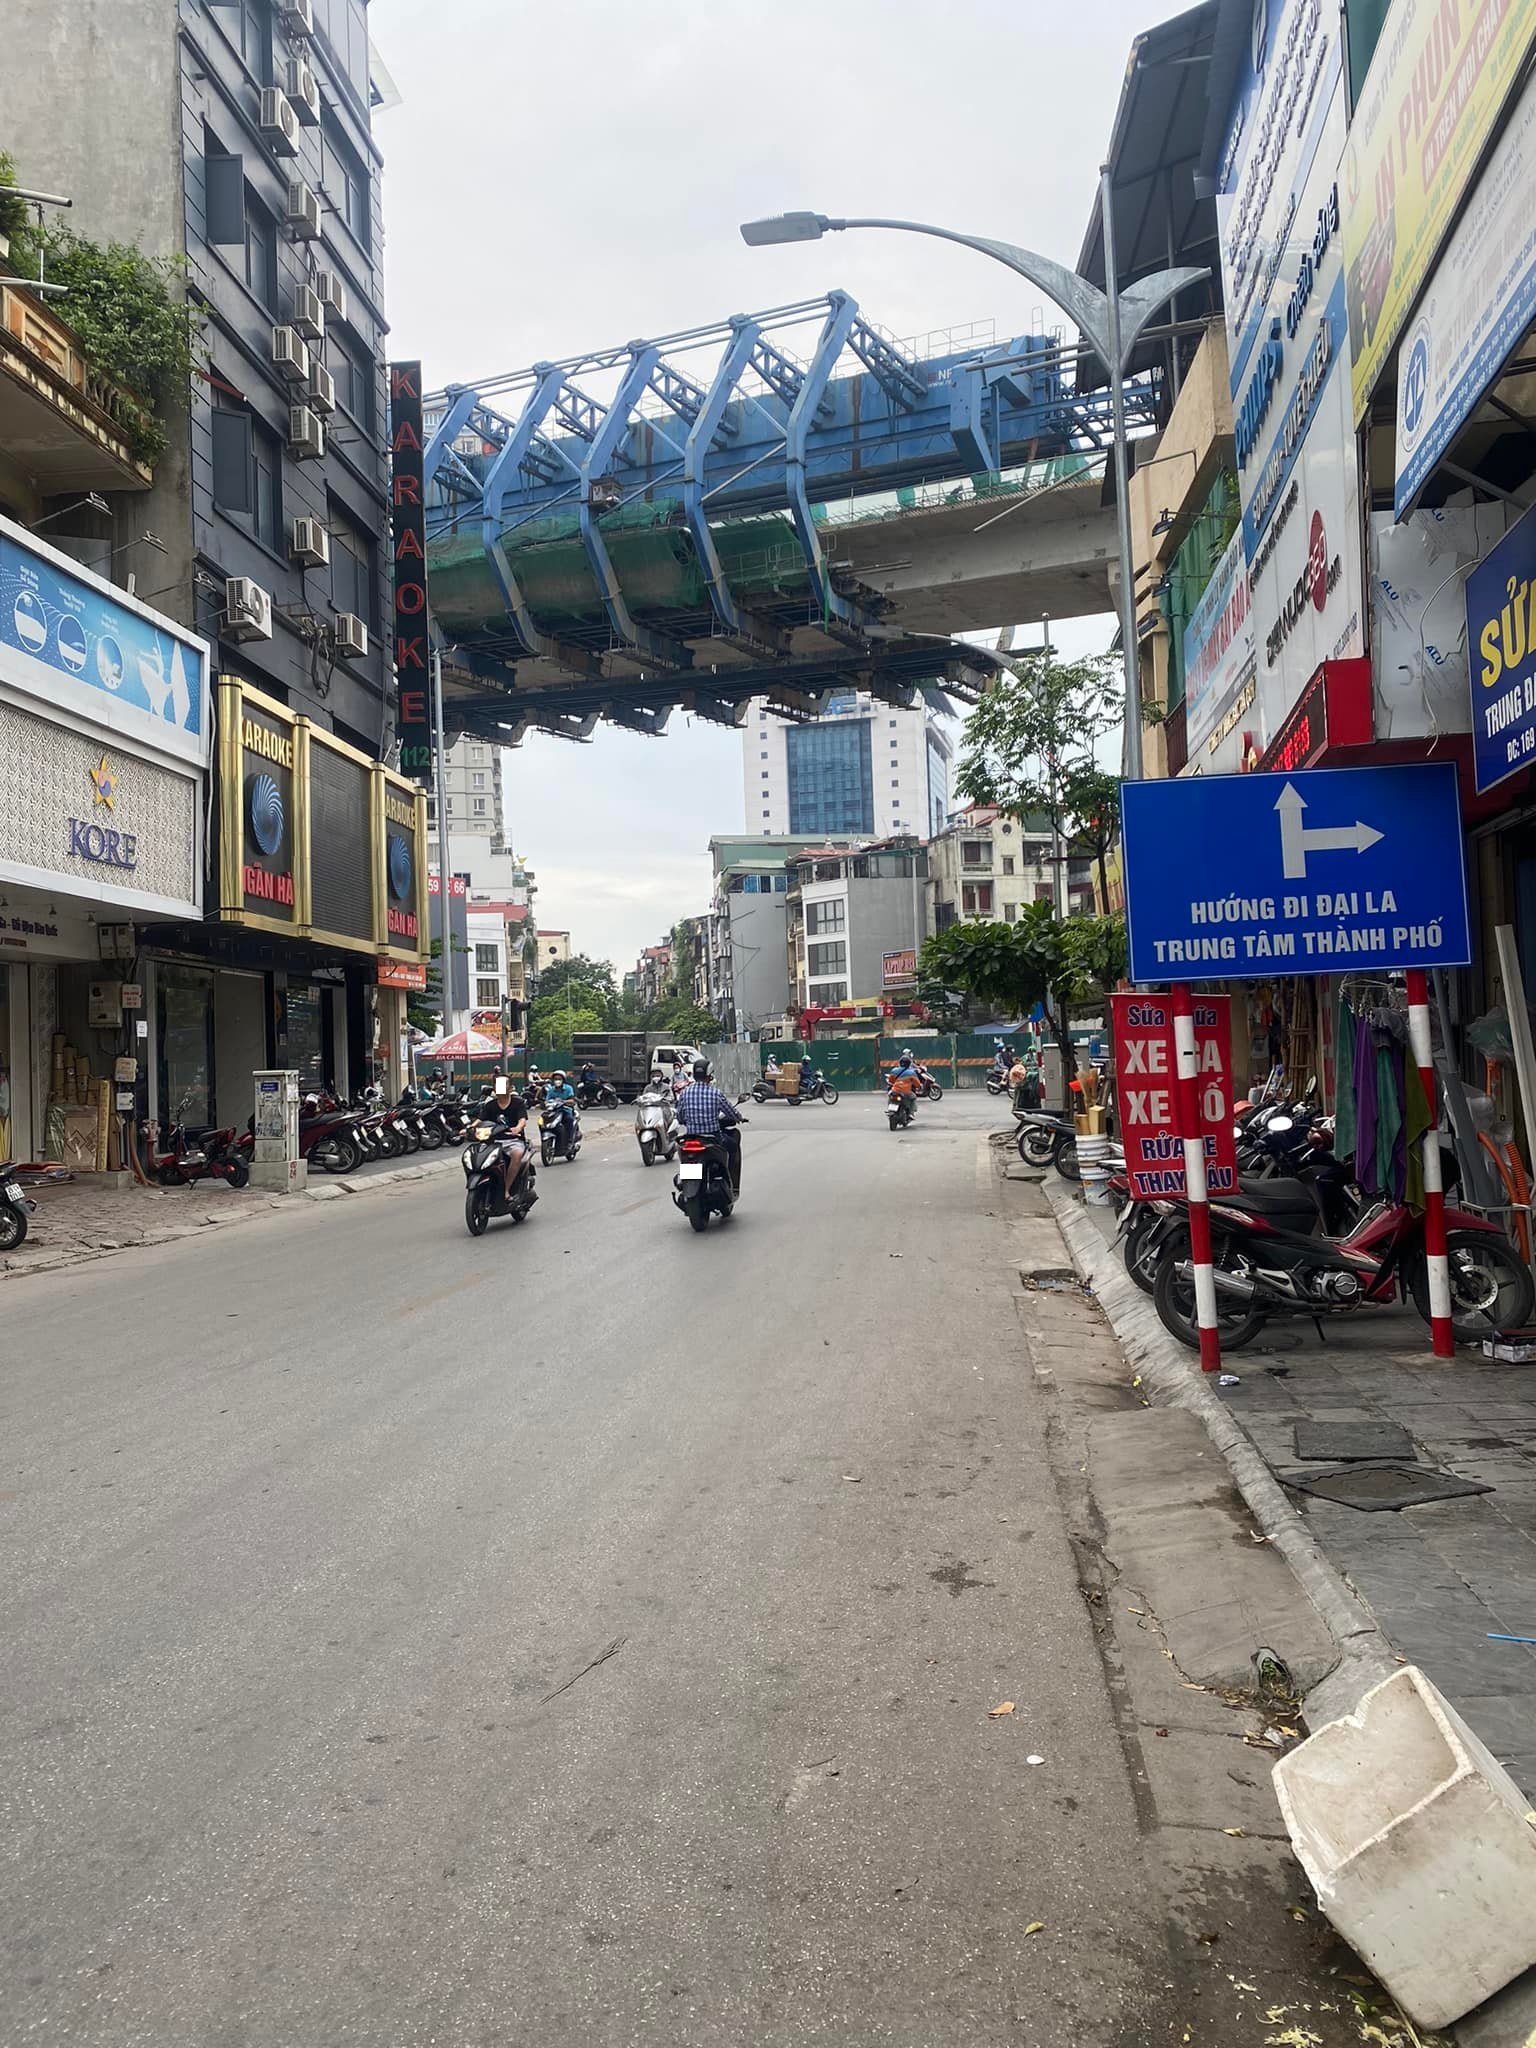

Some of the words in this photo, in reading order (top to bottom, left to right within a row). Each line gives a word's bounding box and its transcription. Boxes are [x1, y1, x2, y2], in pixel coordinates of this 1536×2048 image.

[1235, 317, 1283, 469] PHILIPS
[391, 368, 426, 724] KARAOKE
[1380, 580, 1399, 601] ALU
[1425, 646, 1444, 666] ALU
[1484, 682, 1523, 739] TRUNG
[1521, 726, 1535, 754] 169
[401, 746, 430, 768] 112
[386, 795, 415, 830] ARAOKE
[67, 816, 138, 871] KORE
[278, 872, 294, 905] HÀ
[388, 905, 406, 933] GÂN
[1191, 893, 1275, 924] HƯỚNG
[1283, 895, 1309, 919] ĐI
[1316, 892, 1359, 921] ĐẠI
[1366, 890, 1397, 914] LA
[1153, 936, 1236, 963] TRUNG
[1243, 930, 1295, 958] TÂM
[1302, 924, 1386, 954] THÀNH
[1393, 916, 1444, 949] PHỐ
[1128, 1002, 1165, 1027] Sửa
[1124, 1039, 1168, 1074] XE
[1125, 1090, 1172, 1125] XE
[1199, 1077, 1225, 1122] Ố
[1140, 1130, 1184, 1161] RỬA
[1202, 1135, 1217, 1157] E
[1134, 1169, 1187, 1195] THAY
[1206, 1162, 1233, 1190] ẦU
